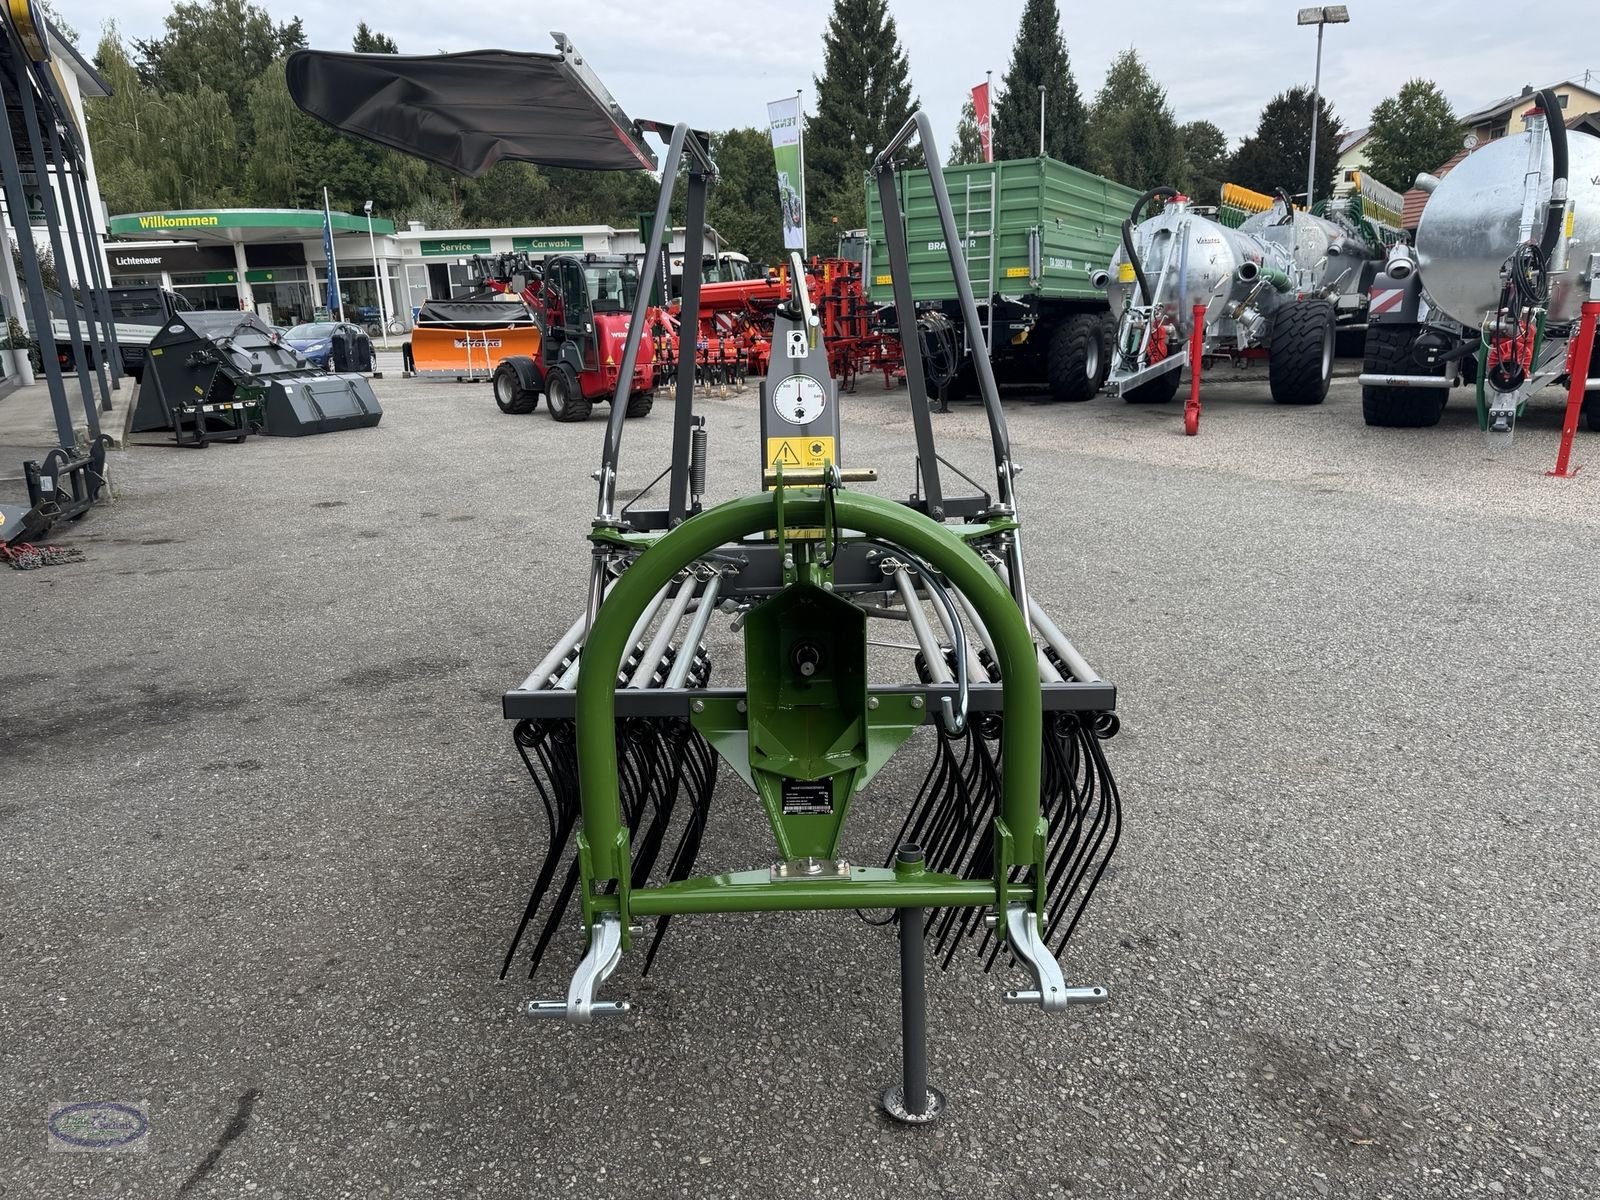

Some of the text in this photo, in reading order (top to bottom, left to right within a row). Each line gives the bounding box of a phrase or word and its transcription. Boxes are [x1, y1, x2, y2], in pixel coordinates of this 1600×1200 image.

[139, 215, 218, 228] Willkommen
[440, 243, 472, 251] Service
[531, 239, 570, 248] Car wash
[116, 256, 162, 266] Lichtenauer
